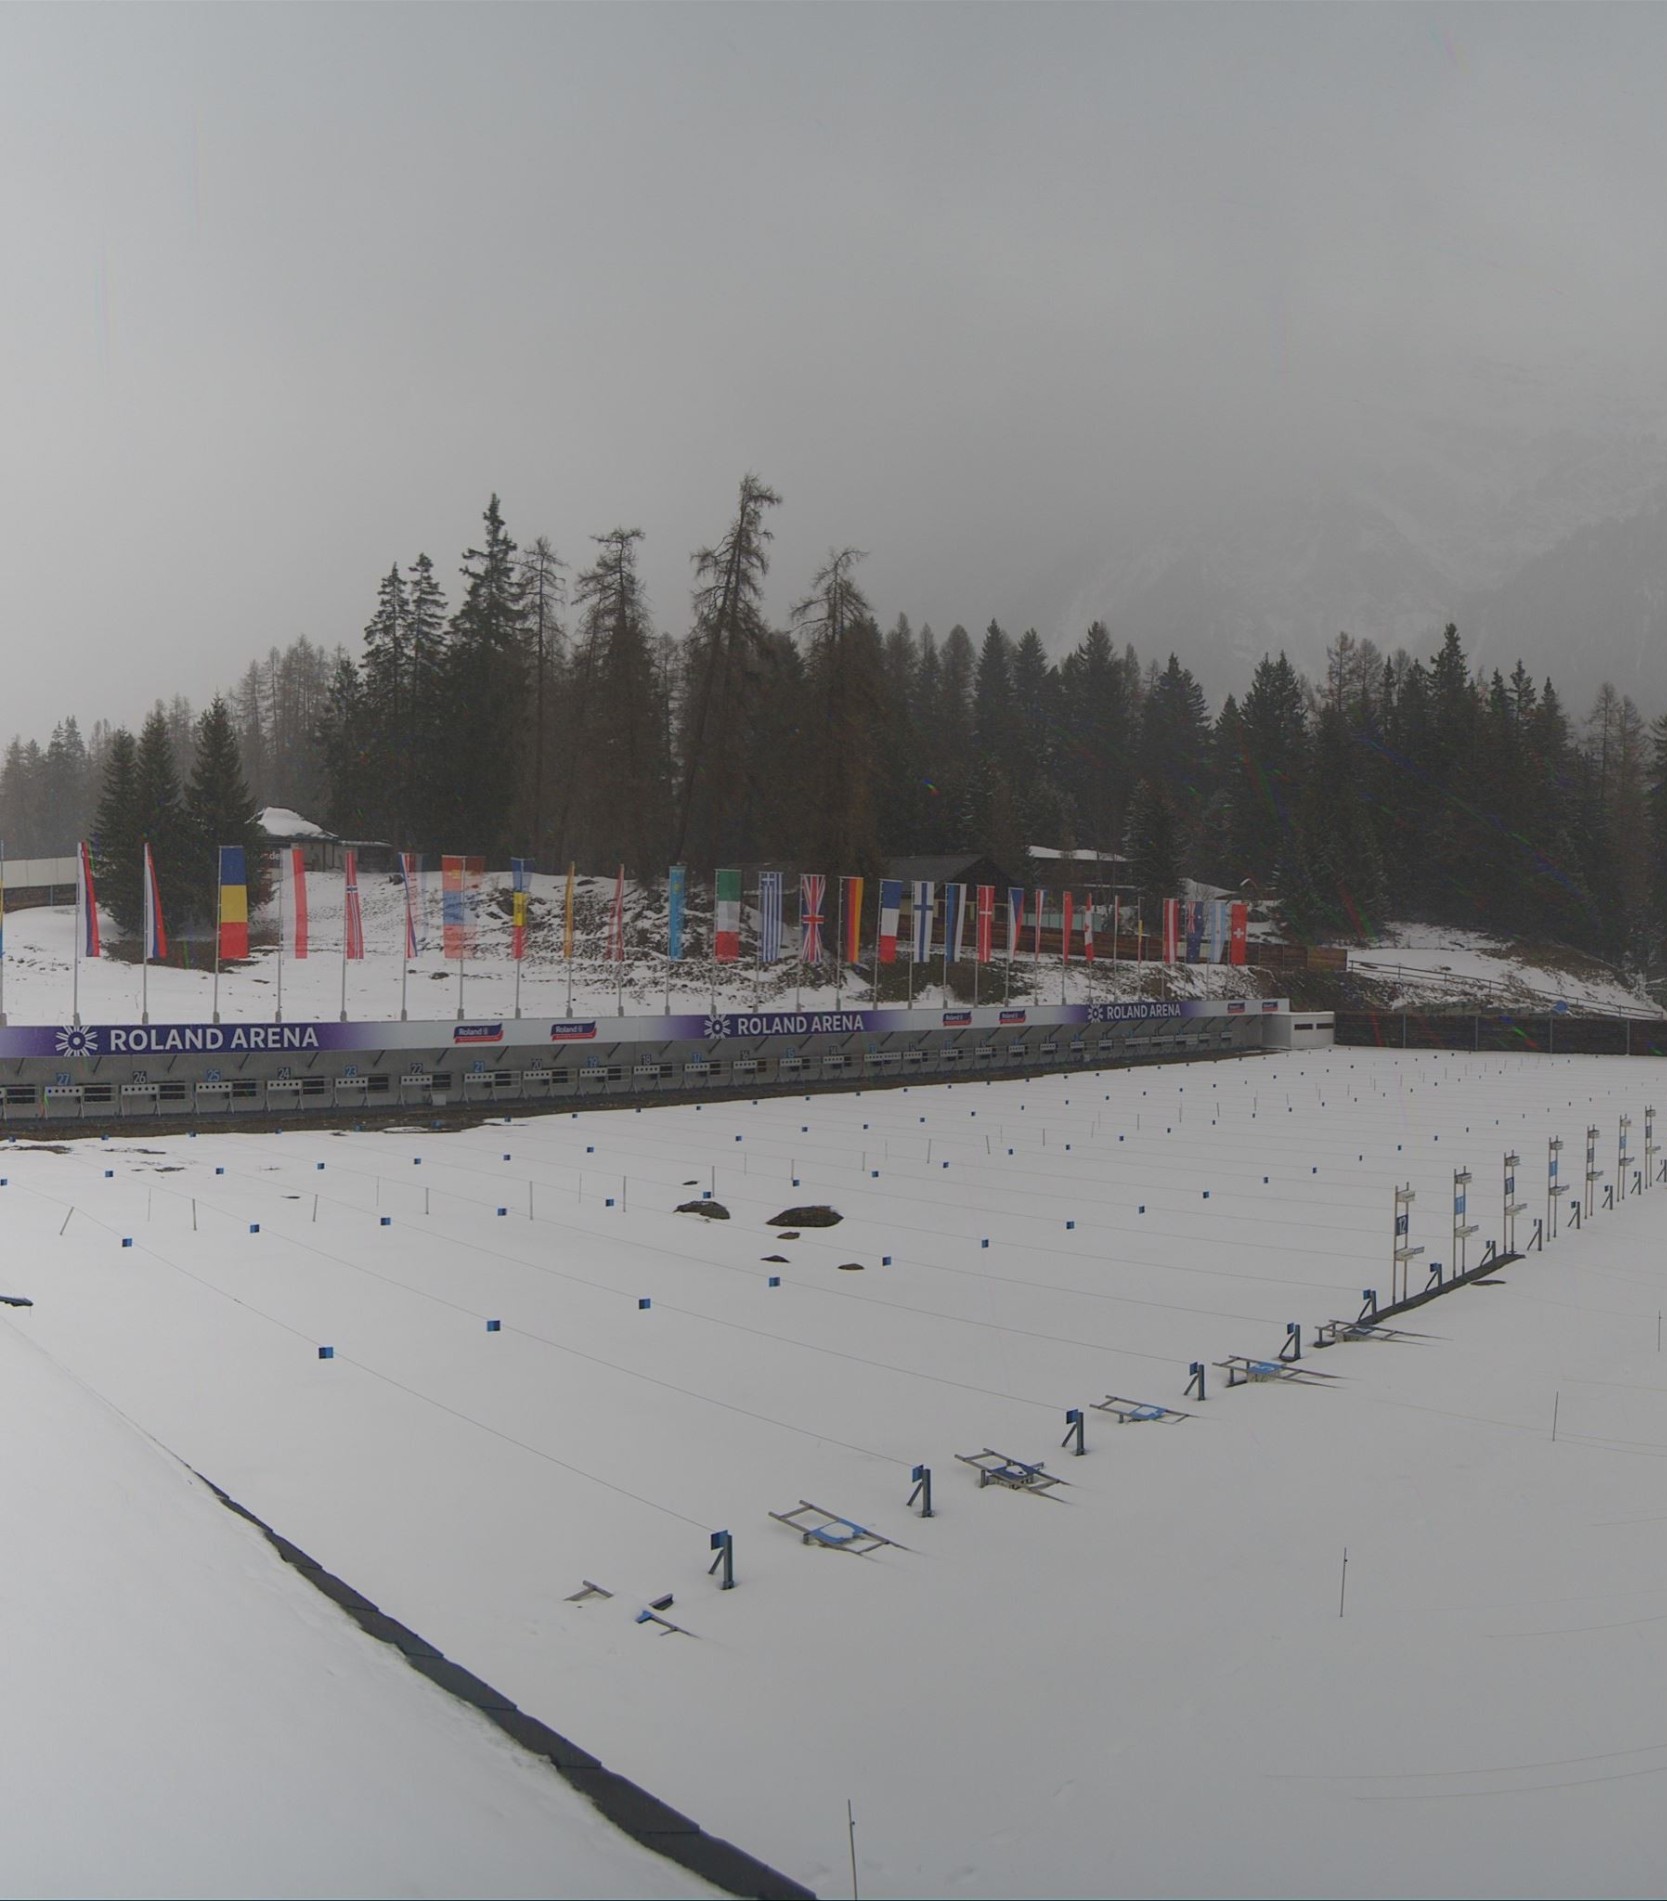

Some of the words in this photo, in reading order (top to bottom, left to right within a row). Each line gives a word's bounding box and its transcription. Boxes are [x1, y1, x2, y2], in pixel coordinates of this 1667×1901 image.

[1107, 1005, 1148, 1019] ROLAND
[1150, 1003, 1181, 1017] ARENA
[555, 1025, 577, 1034] Roland
[737, 1017, 807, 1035] ROLAND
[811, 1014, 864, 1032] ARENA
[459, 1027, 482, 1036] Roland
[109, 1028, 224, 1051] ROLAND
[230, 1027, 319, 1049] ARENA
[346, 1066, 358, 1077] 23
[410, 1063, 422, 1074] 22
[474, 1062, 485, 1073] 21
[133, 1072, 146, 1083] 26
[207, 1070, 220, 1081] 25
[278, 1068, 290, 1079] 24
[57, 1074, 70, 1085] 27
[1398, 1216, 1407, 1234] 12
